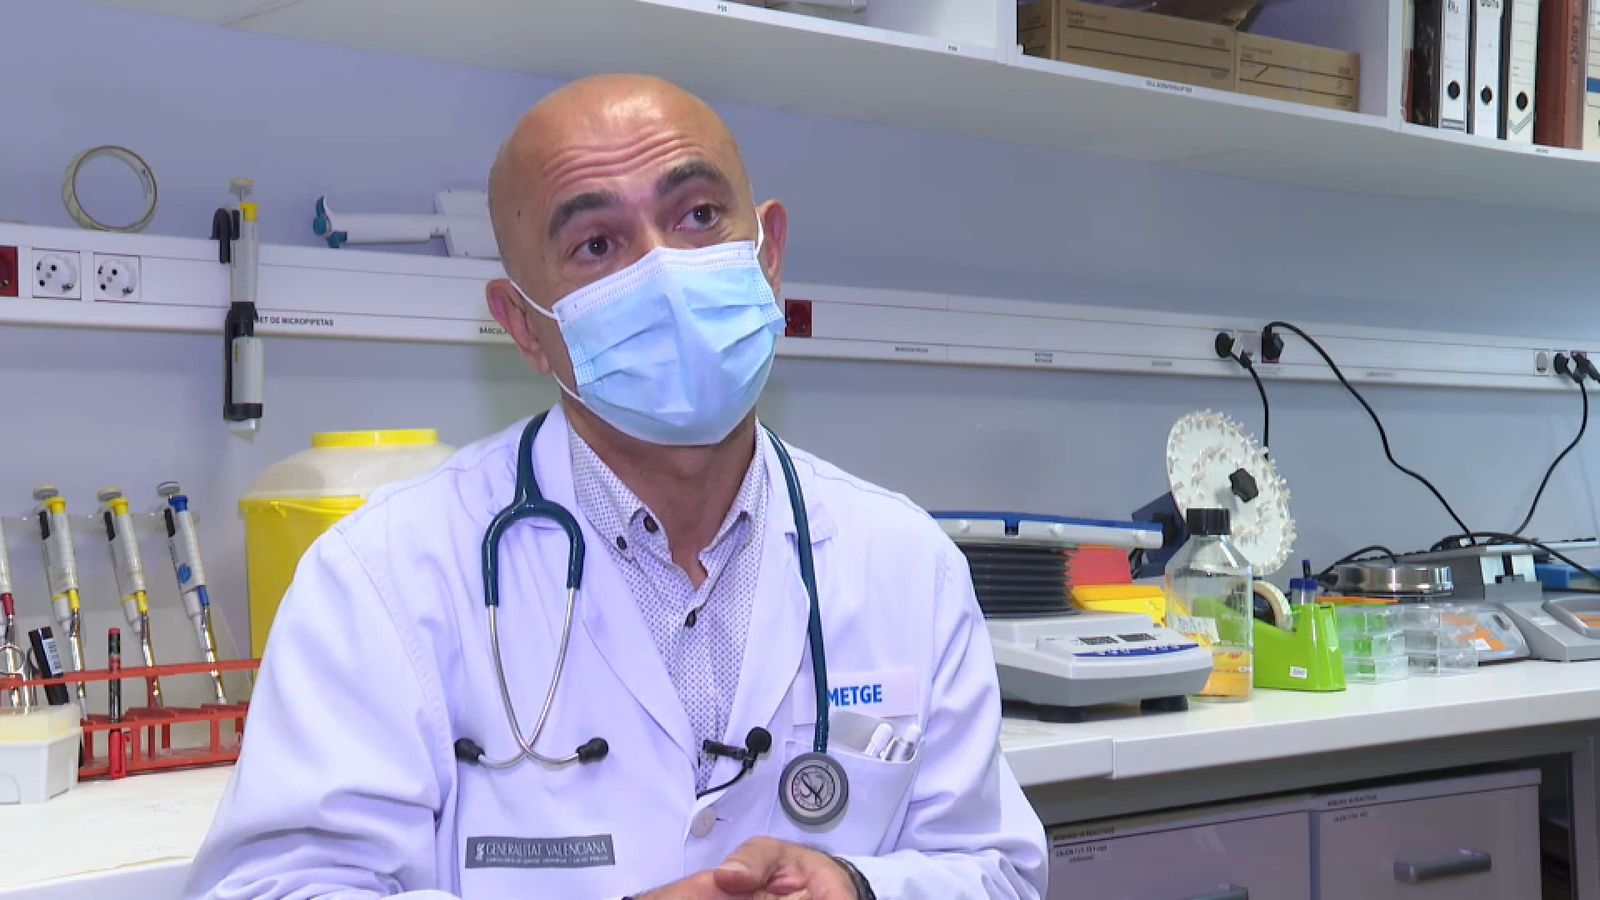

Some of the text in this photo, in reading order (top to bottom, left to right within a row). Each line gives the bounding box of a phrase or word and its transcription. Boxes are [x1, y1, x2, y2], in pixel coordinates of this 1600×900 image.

[270, 316, 280, 324] DE
[281, 317, 334, 326] MICROPIPETAS
[826, 684, 882, 707] METGE
[486, 840, 608, 857] GENERALITAT VALENCIANA
